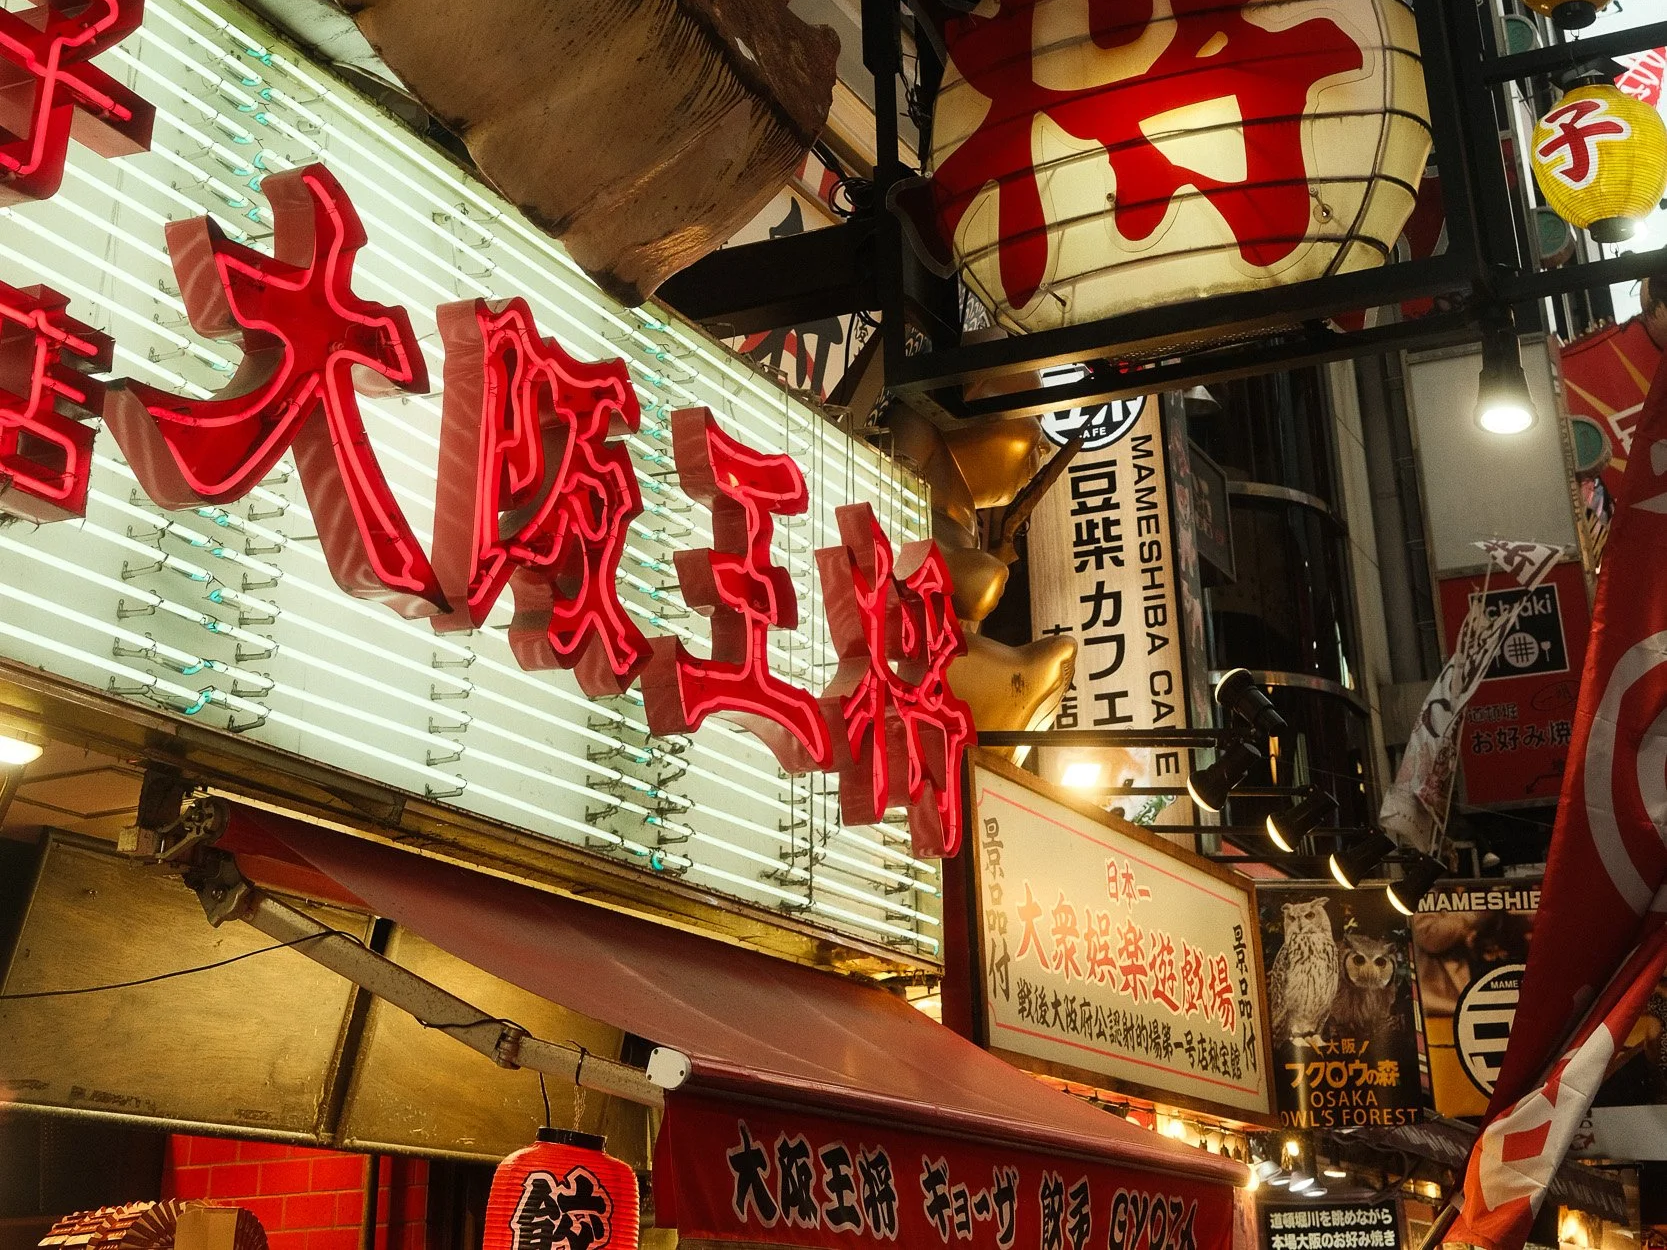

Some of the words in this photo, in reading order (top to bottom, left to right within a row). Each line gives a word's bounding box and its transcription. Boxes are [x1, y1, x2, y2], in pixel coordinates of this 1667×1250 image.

[1130, 434, 1169, 656] MAMESHIBA
[1149, 669, 1180, 777] CAE
[982, 817, 1010, 1002] 景品付
[1106, 860, 1151, 908] 日本一
[1015, 880, 1237, 1035] 大衆娯楽遊戯場
[1232, 924, 1258, 1073] 景品付
[1490, 979, 1519, 989] MAME
[1310, 1090, 1378, 1108] OSAKA
[1326, 1038, 1356, 1055] 大阪
[1342, 1108, 1418, 1126] FOREST
[727, 1119, 898, 1241] 大阪王将
[921, 1155, 1018, 1249] ギョーザ
